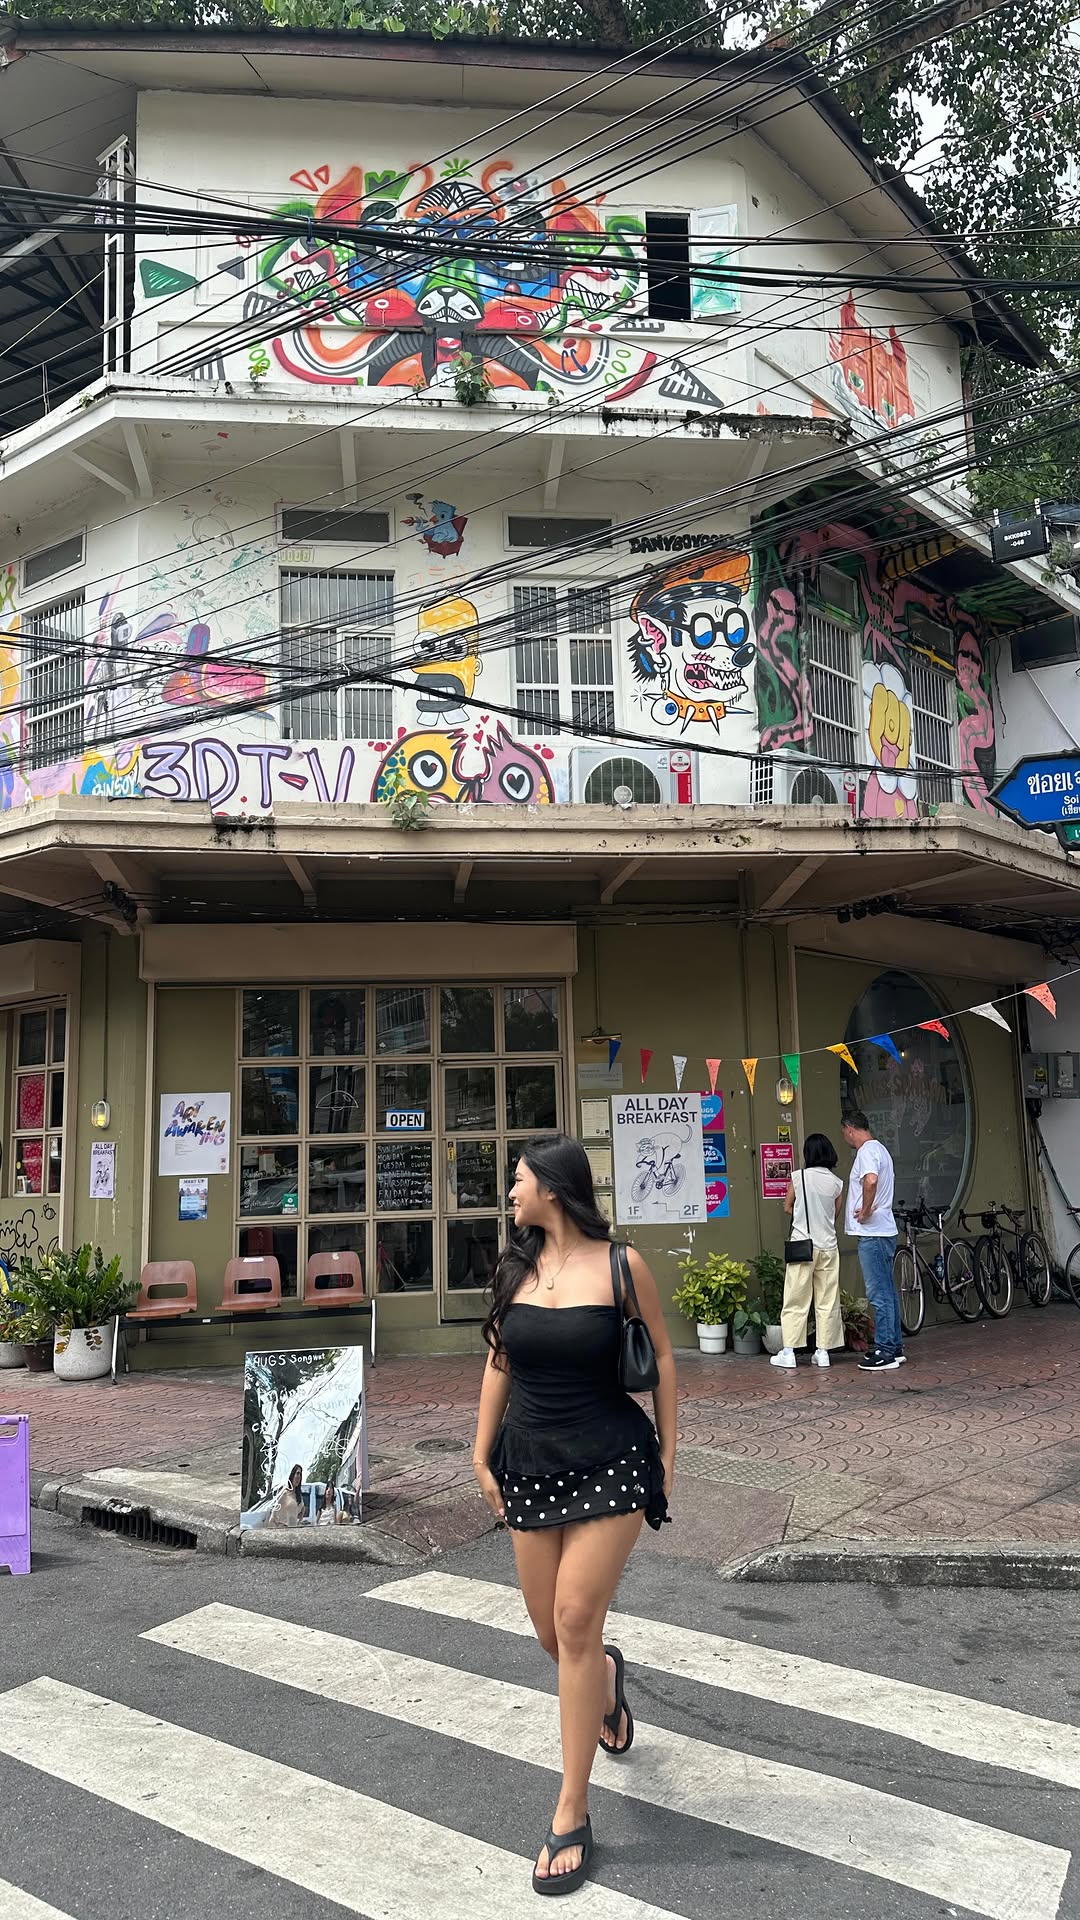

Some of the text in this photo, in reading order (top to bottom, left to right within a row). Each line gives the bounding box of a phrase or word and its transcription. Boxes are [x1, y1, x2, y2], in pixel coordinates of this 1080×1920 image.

[1064, 794, 1079, 805] Soi
[625, 1097, 688, 1111] ALL DAY
[172, 1100, 205, 1123] ART
[390, 1113, 422, 1127] OPEN
[617, 1112, 698, 1124] BREAKFAST
[164, 1116, 226, 1137] AWAKEN
[377, 1152, 405, 1161] MONDAY
[377, 1161, 406, 1170] TUESDAY
[378, 1188, 407, 1198] FRIDAY
[628, 1204, 699, 1216] 1F 2F
[253, 1352, 325, 1367] HUGS Songwat
